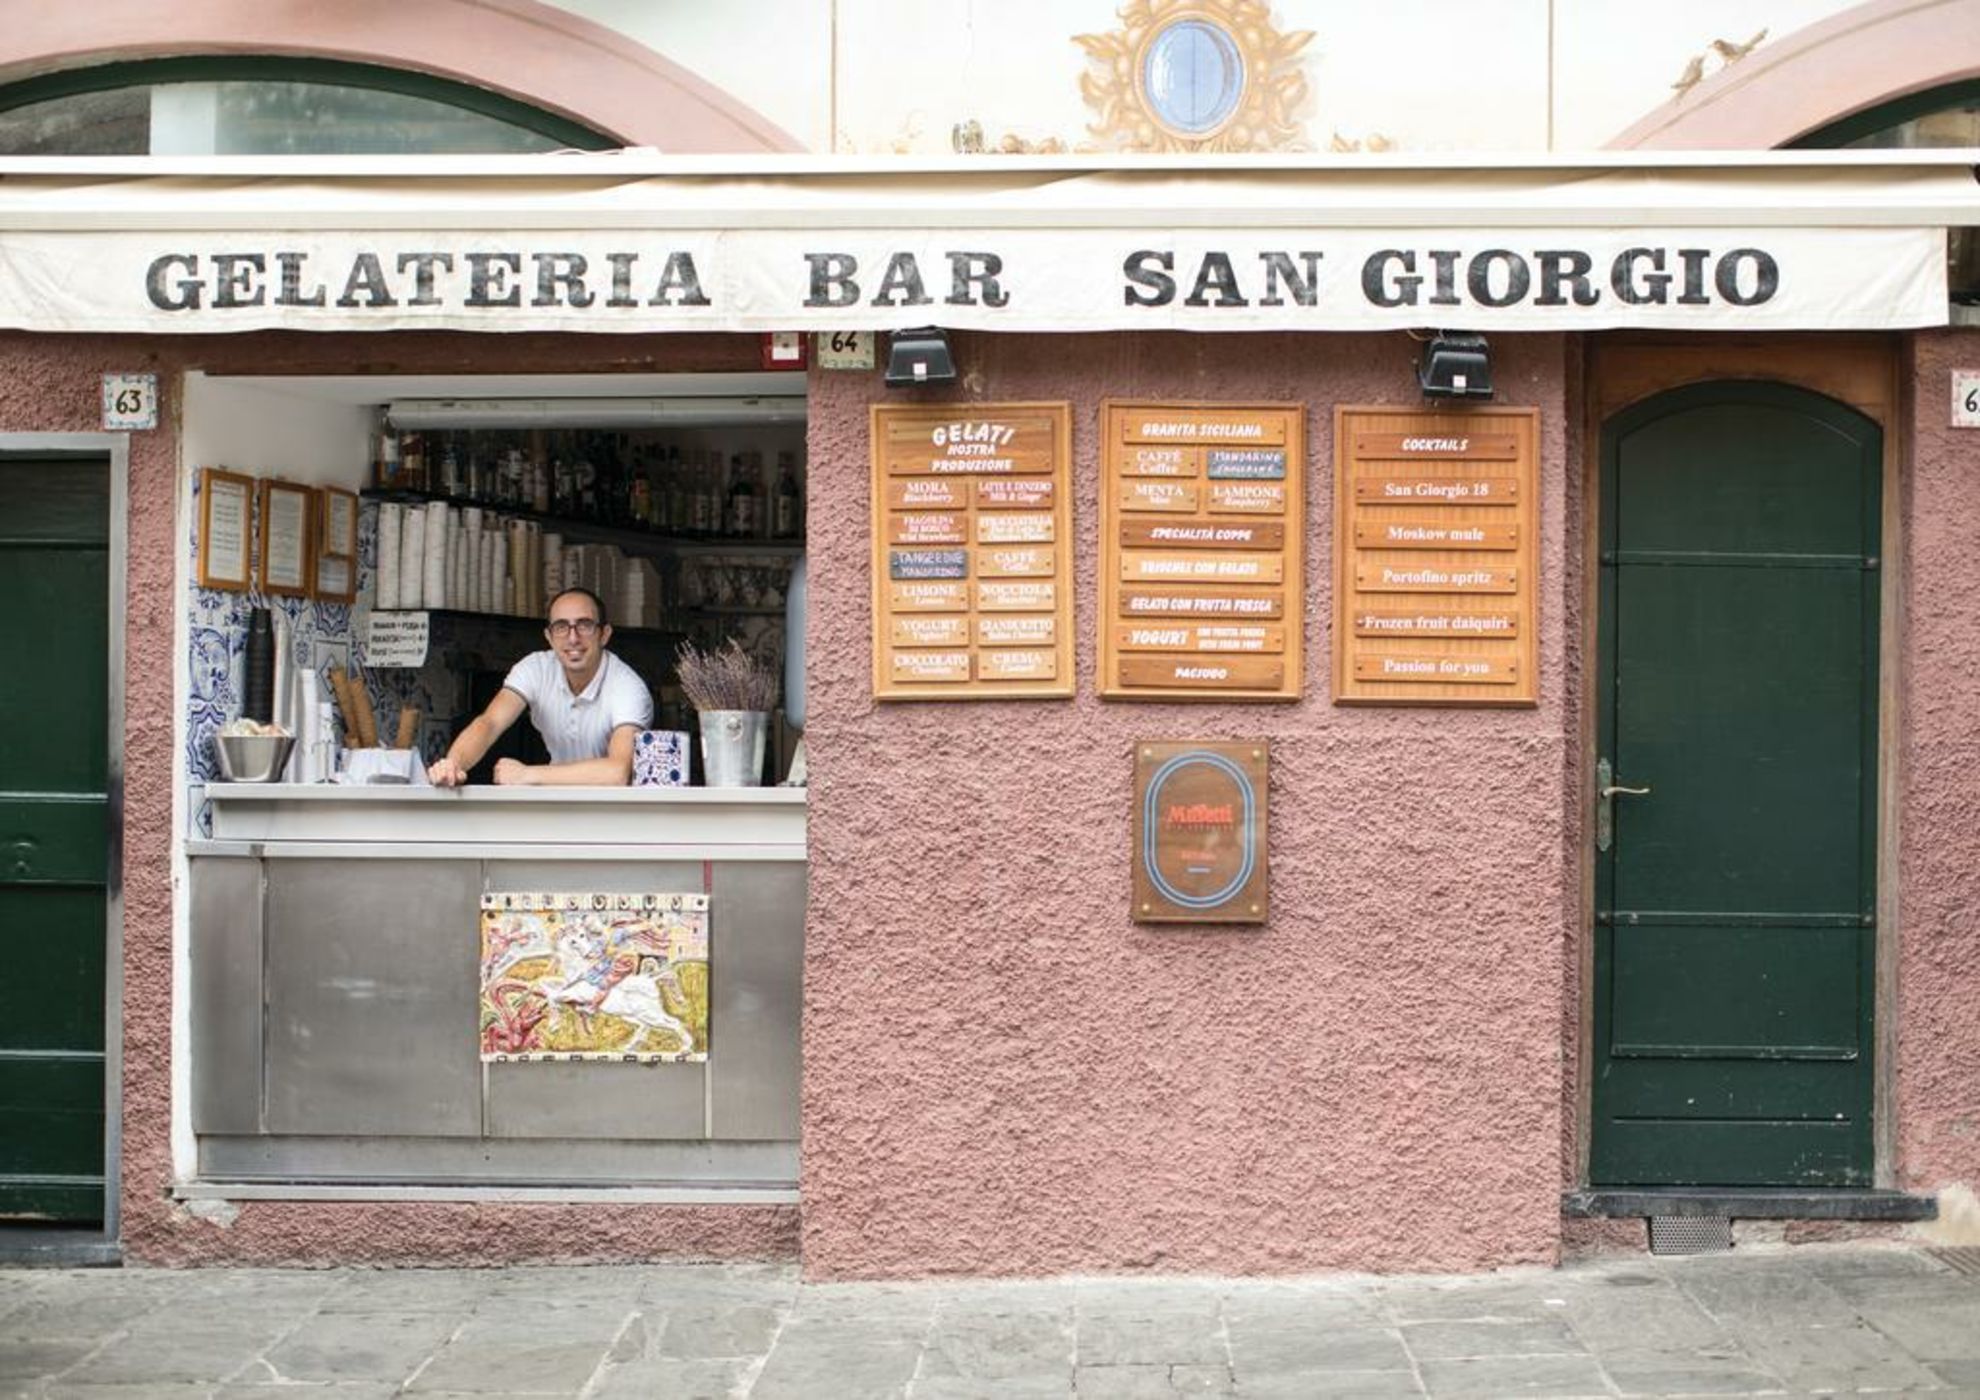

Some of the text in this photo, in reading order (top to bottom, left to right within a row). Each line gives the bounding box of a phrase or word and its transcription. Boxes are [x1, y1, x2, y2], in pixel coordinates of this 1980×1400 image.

[145, 247, 1779, 311] GELATERIA BAR SAN GIORGIO
[831, 331, 858, 352] 64
[116, 390, 141, 414] 63
[1965, 388, 1980, 412] 6
[932, 422, 1015, 446] GELATI
[1142, 423, 1262, 436] GRANITA SICILIANA
[947, 444, 996, 456] NOSTRA
[1402, 438, 1469, 451] COCKTAILS
[931, 459, 1014, 473] PRODUZIONE
[1140, 463, 1178, 474] Coffee
[906, 481, 949, 493] MORA
[1135, 484, 1184, 496] MENTA
[1214, 485, 1281, 499] LAMPONE
[1384, 482, 1489, 499] San Giorgio 18
[1216, 529, 1253, 541] COPPE
[1387, 527, 1485, 541] Moskow mule
[1383, 569, 1492, 586] Portofino spritz
[902, 584, 956, 597] LIMONE
[1131, 597, 1272, 612] GELATO CON FRUTTA FRESCA
[901, 620, 959, 632] YOGURT
[1364, 616, 1508, 632] Frozen fruit daiquiri
[1131, 630, 1189, 645] YOGURT
[1384, 660, 1489, 676] Passion for you
